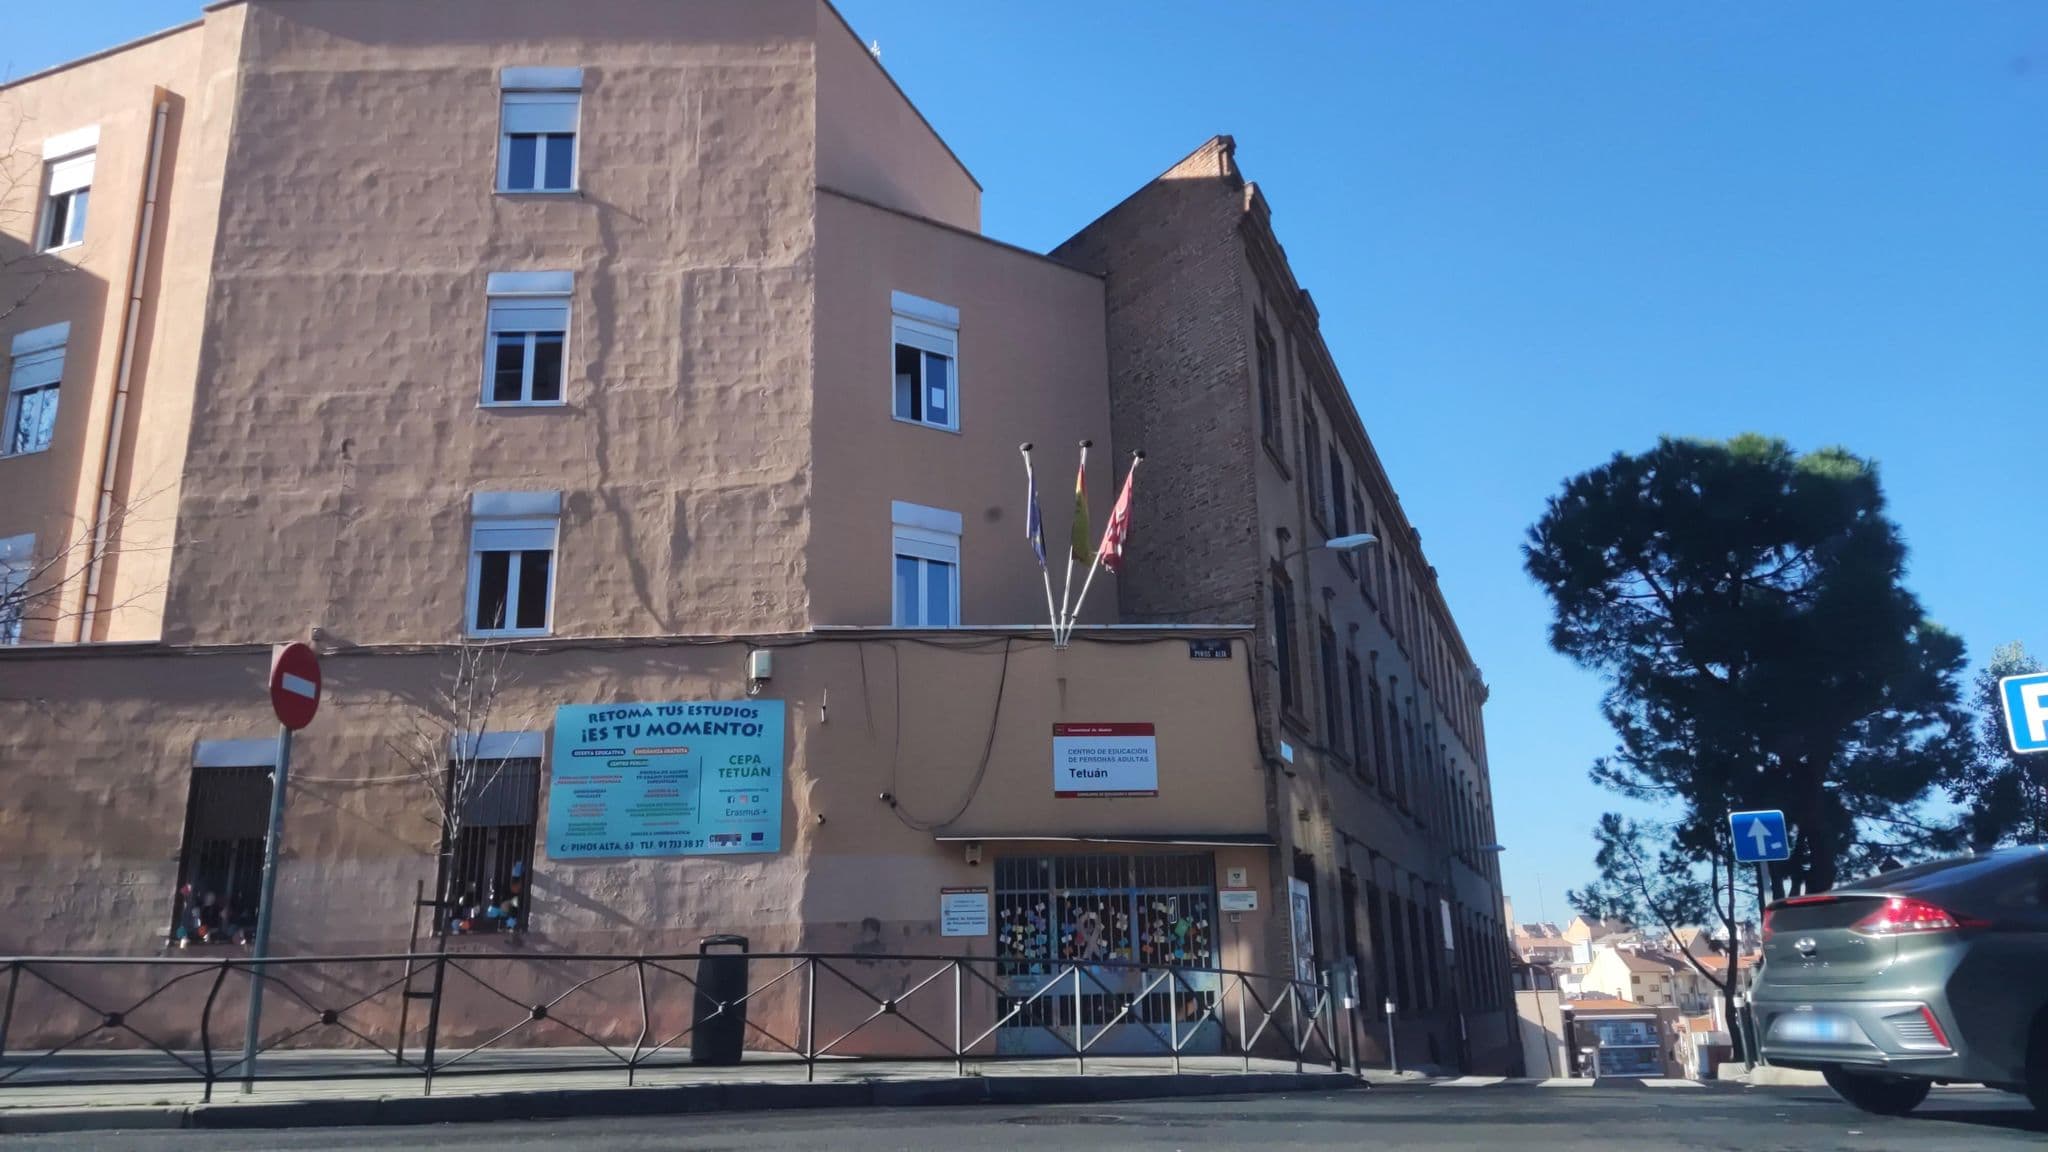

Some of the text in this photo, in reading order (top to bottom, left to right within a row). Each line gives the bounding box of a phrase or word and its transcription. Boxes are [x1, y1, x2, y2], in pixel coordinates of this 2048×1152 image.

[589, 705, 759, 723] RETOMA TUS ESTUDIOS
[581, 721, 764, 743] ¡ES TU MOMENTO!
[729, 754, 762, 765] CEPA
[1069, 768, 1108, 778] Tetuán
[726, 808, 760, 817] Erasmus
[571, 843, 597, 851] PINOS
